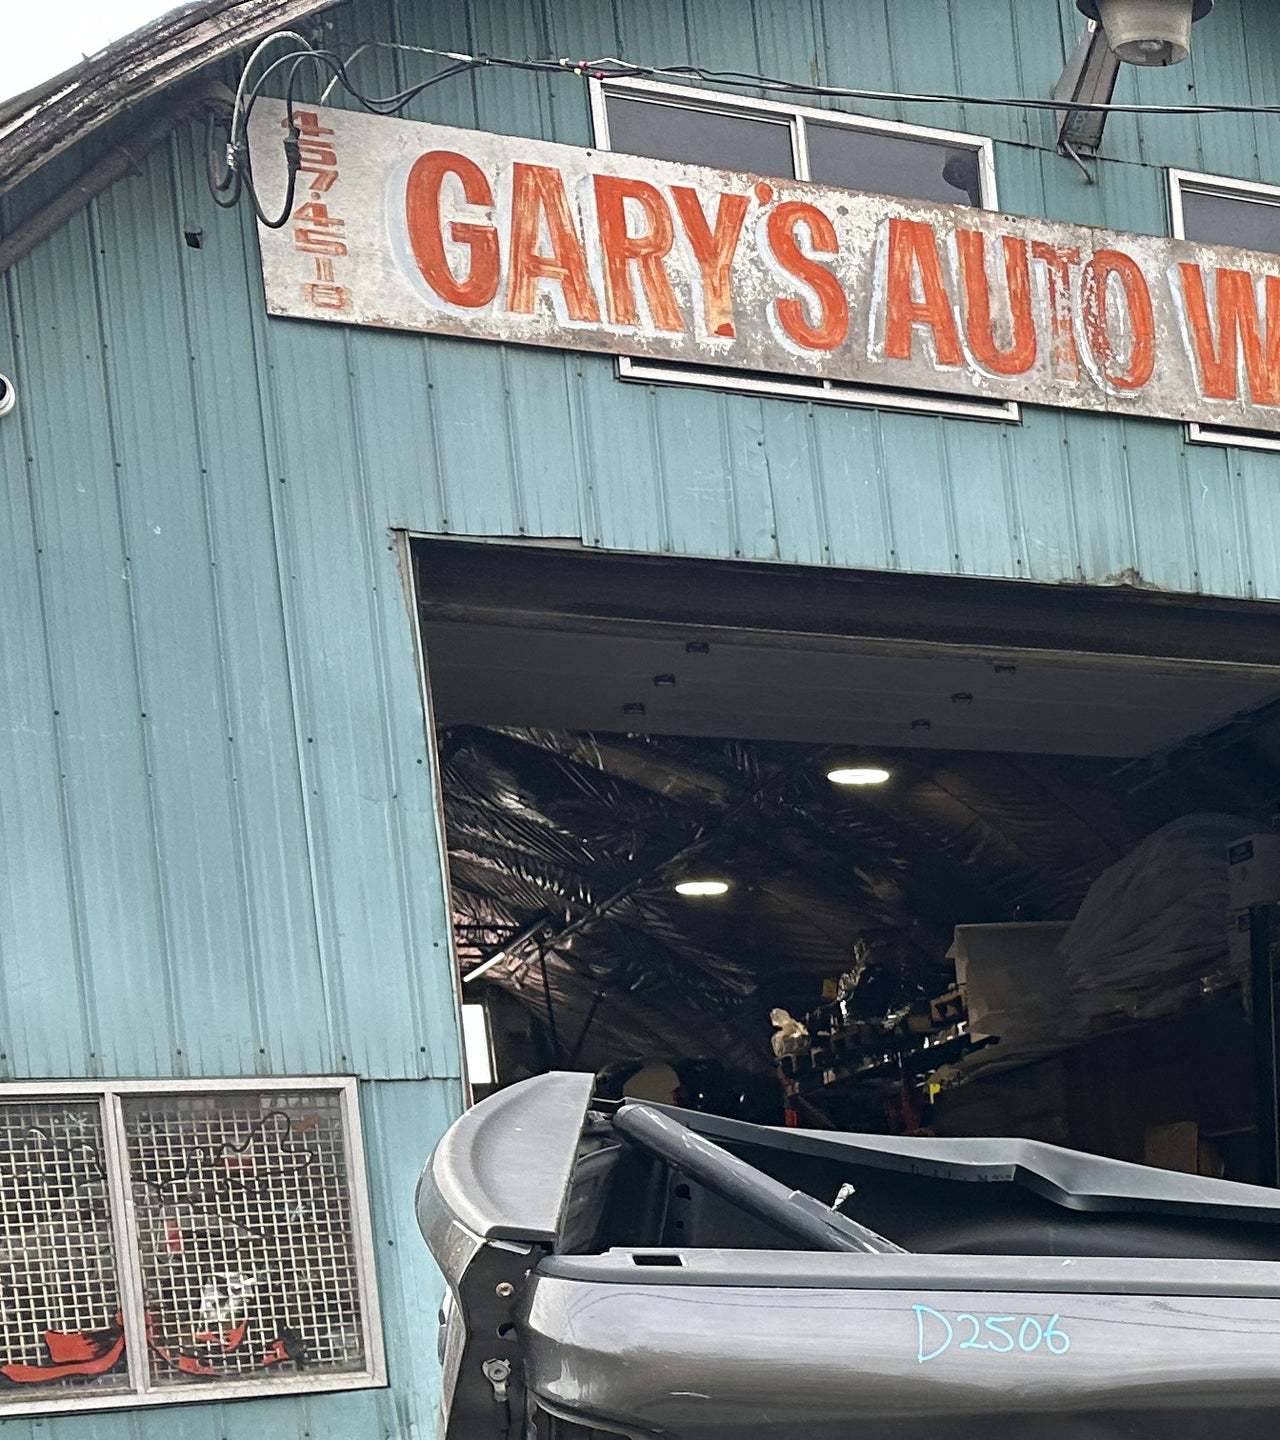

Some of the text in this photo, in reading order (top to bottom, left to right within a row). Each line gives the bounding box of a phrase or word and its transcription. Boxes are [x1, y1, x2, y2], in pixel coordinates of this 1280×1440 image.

[405, 149, 849, 352] GARY'S
[885, 216, 1156, 391] AUTO
[911, 1304, 1071, 1364] D2506
